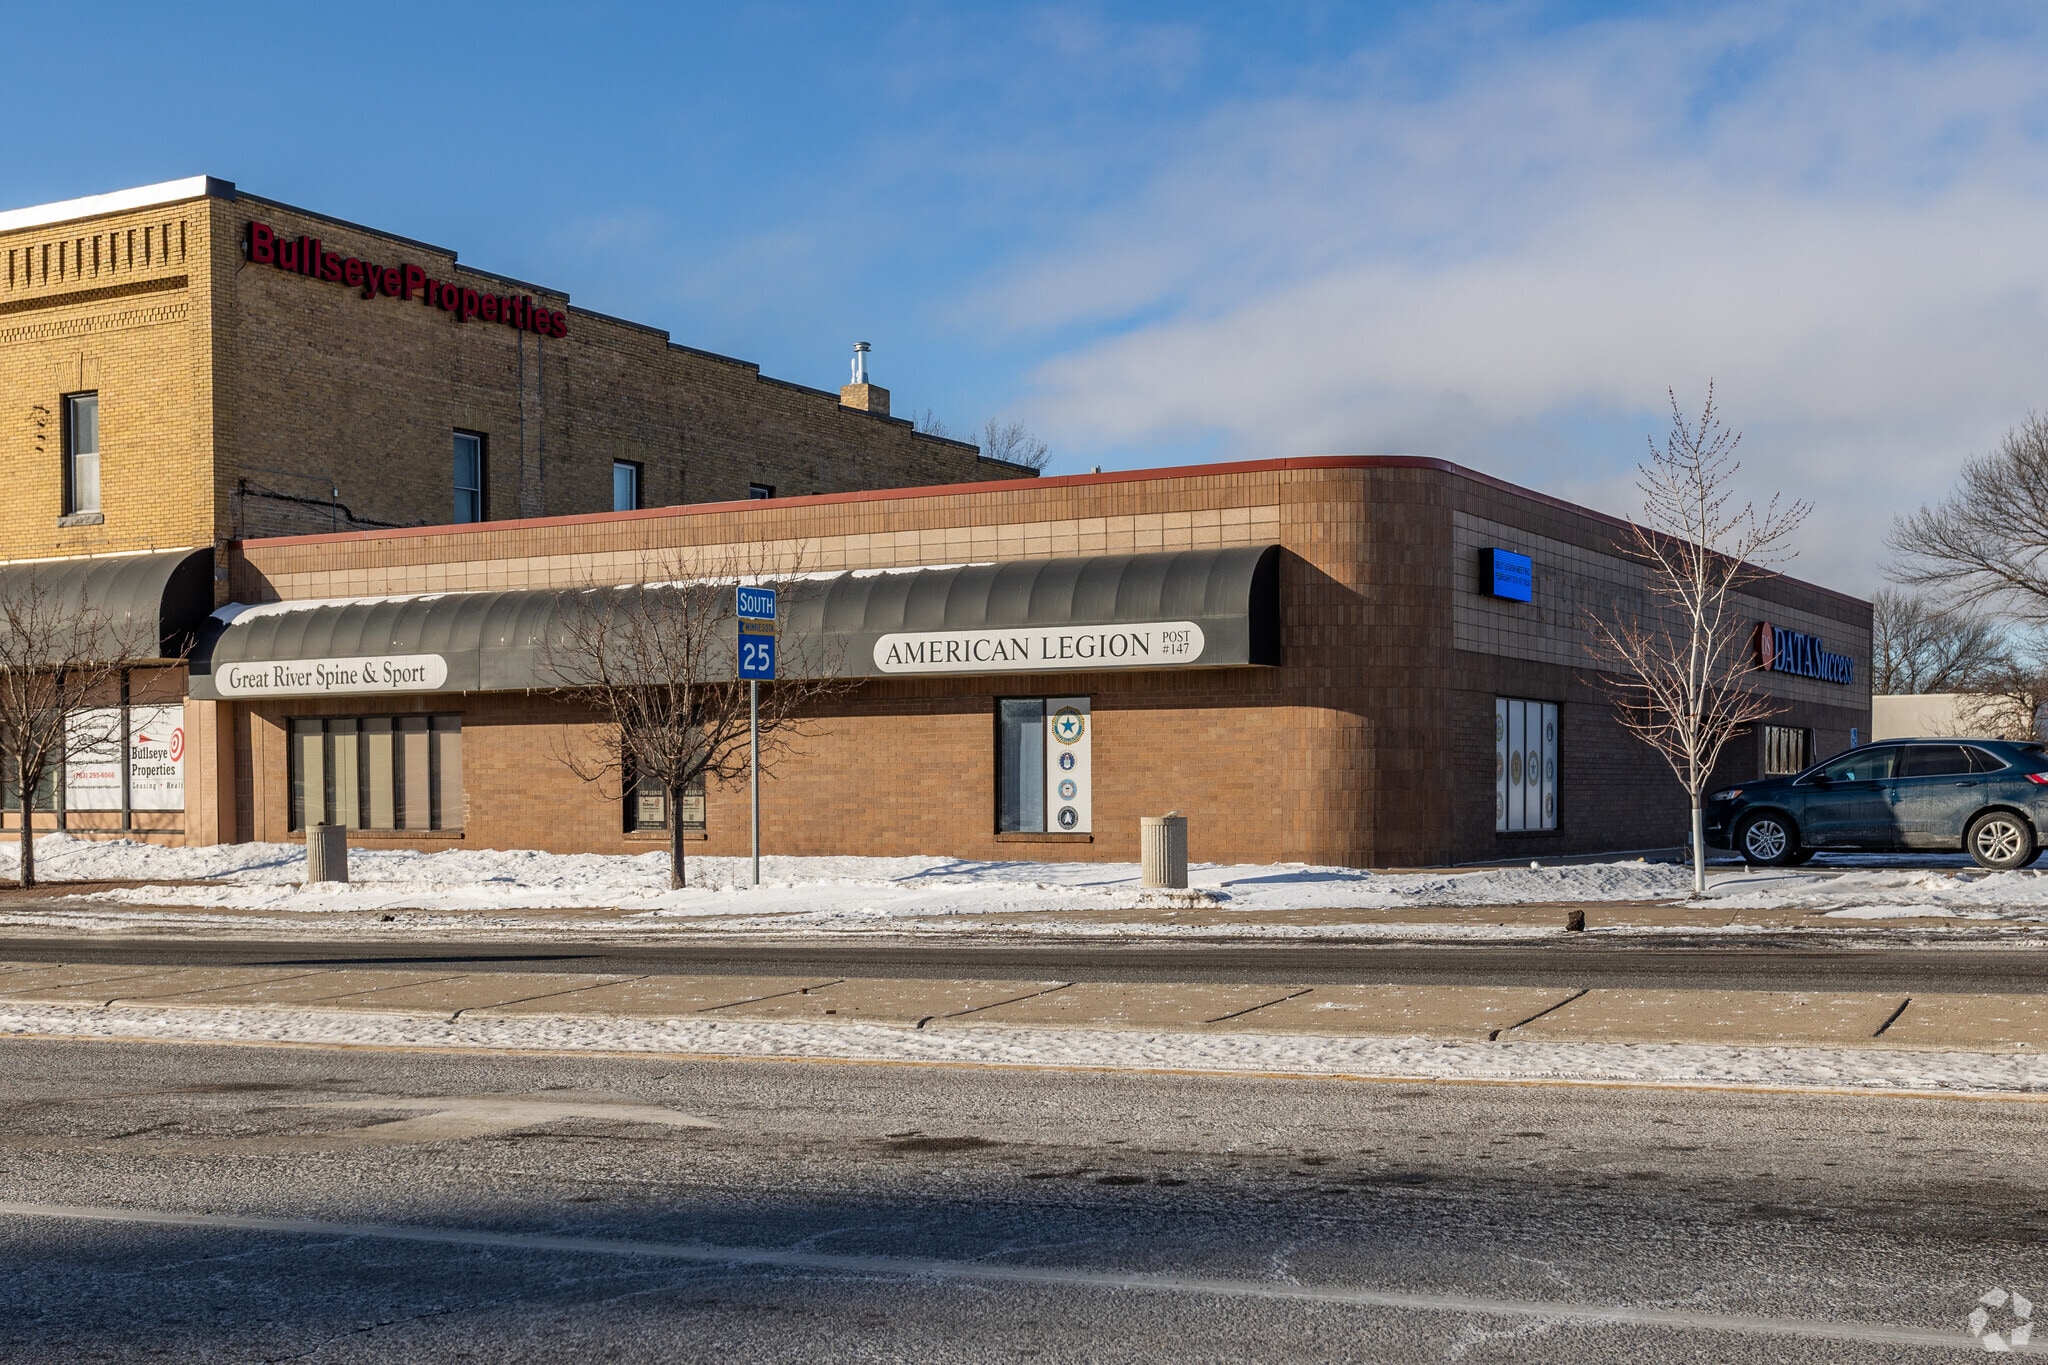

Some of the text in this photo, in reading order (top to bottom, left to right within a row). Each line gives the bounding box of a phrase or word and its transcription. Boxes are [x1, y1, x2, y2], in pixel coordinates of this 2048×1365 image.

[740, 592, 773, 614] SOUTH
[745, 623, 774, 632] MINNESOTA
[1162, 630, 1191, 643] POST
[885, 632, 1151, 665] AMERICAN LEGION
[1162, 642, 1190, 655] #147
[1762, 635, 1771, 655] DS
[743, 643, 770, 671] 25
[229, 660, 426, 690] Great River Spine & Sport
[131, 746, 168, 761] Bullseye
[131, 763, 176, 778] Properties
[132, 781, 157, 790] Leasing
